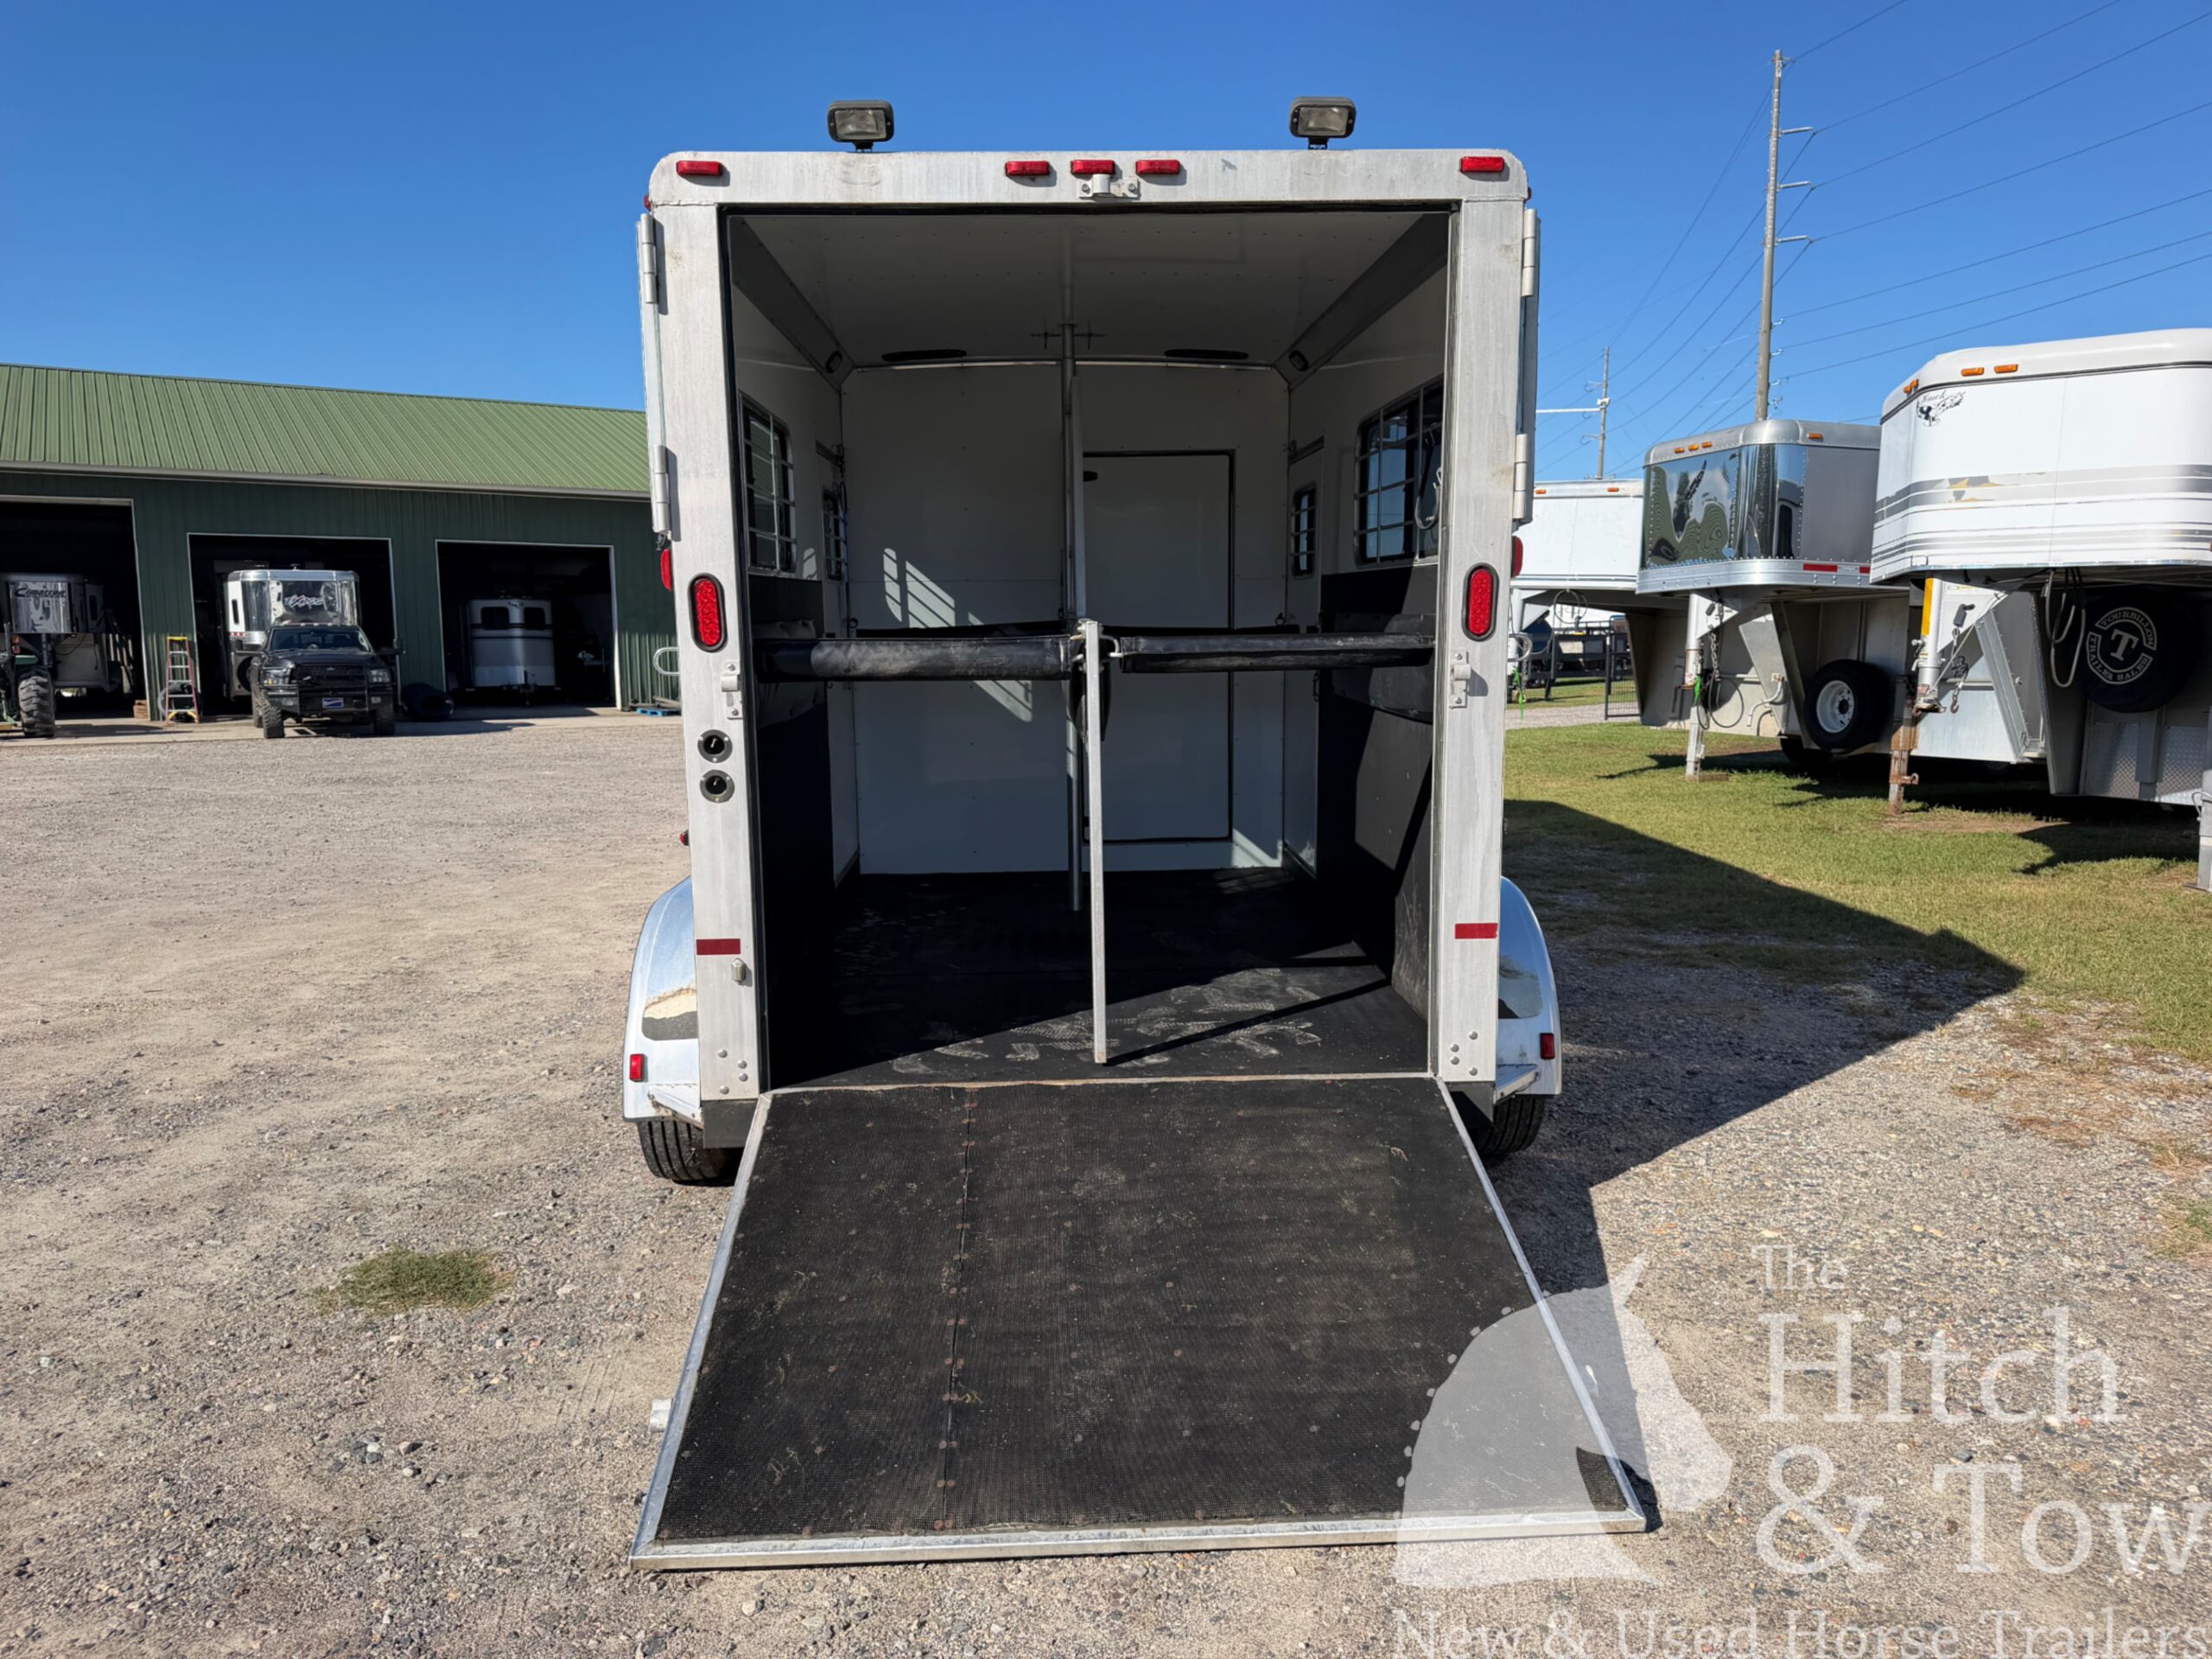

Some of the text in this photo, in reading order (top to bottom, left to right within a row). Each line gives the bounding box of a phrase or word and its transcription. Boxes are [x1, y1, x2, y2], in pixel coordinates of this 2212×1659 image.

[2101, 611, 2154, 645] TOURBILLON
[2110, 628, 2139, 661] T
[2089, 636, 2113, 680] TRAILER
